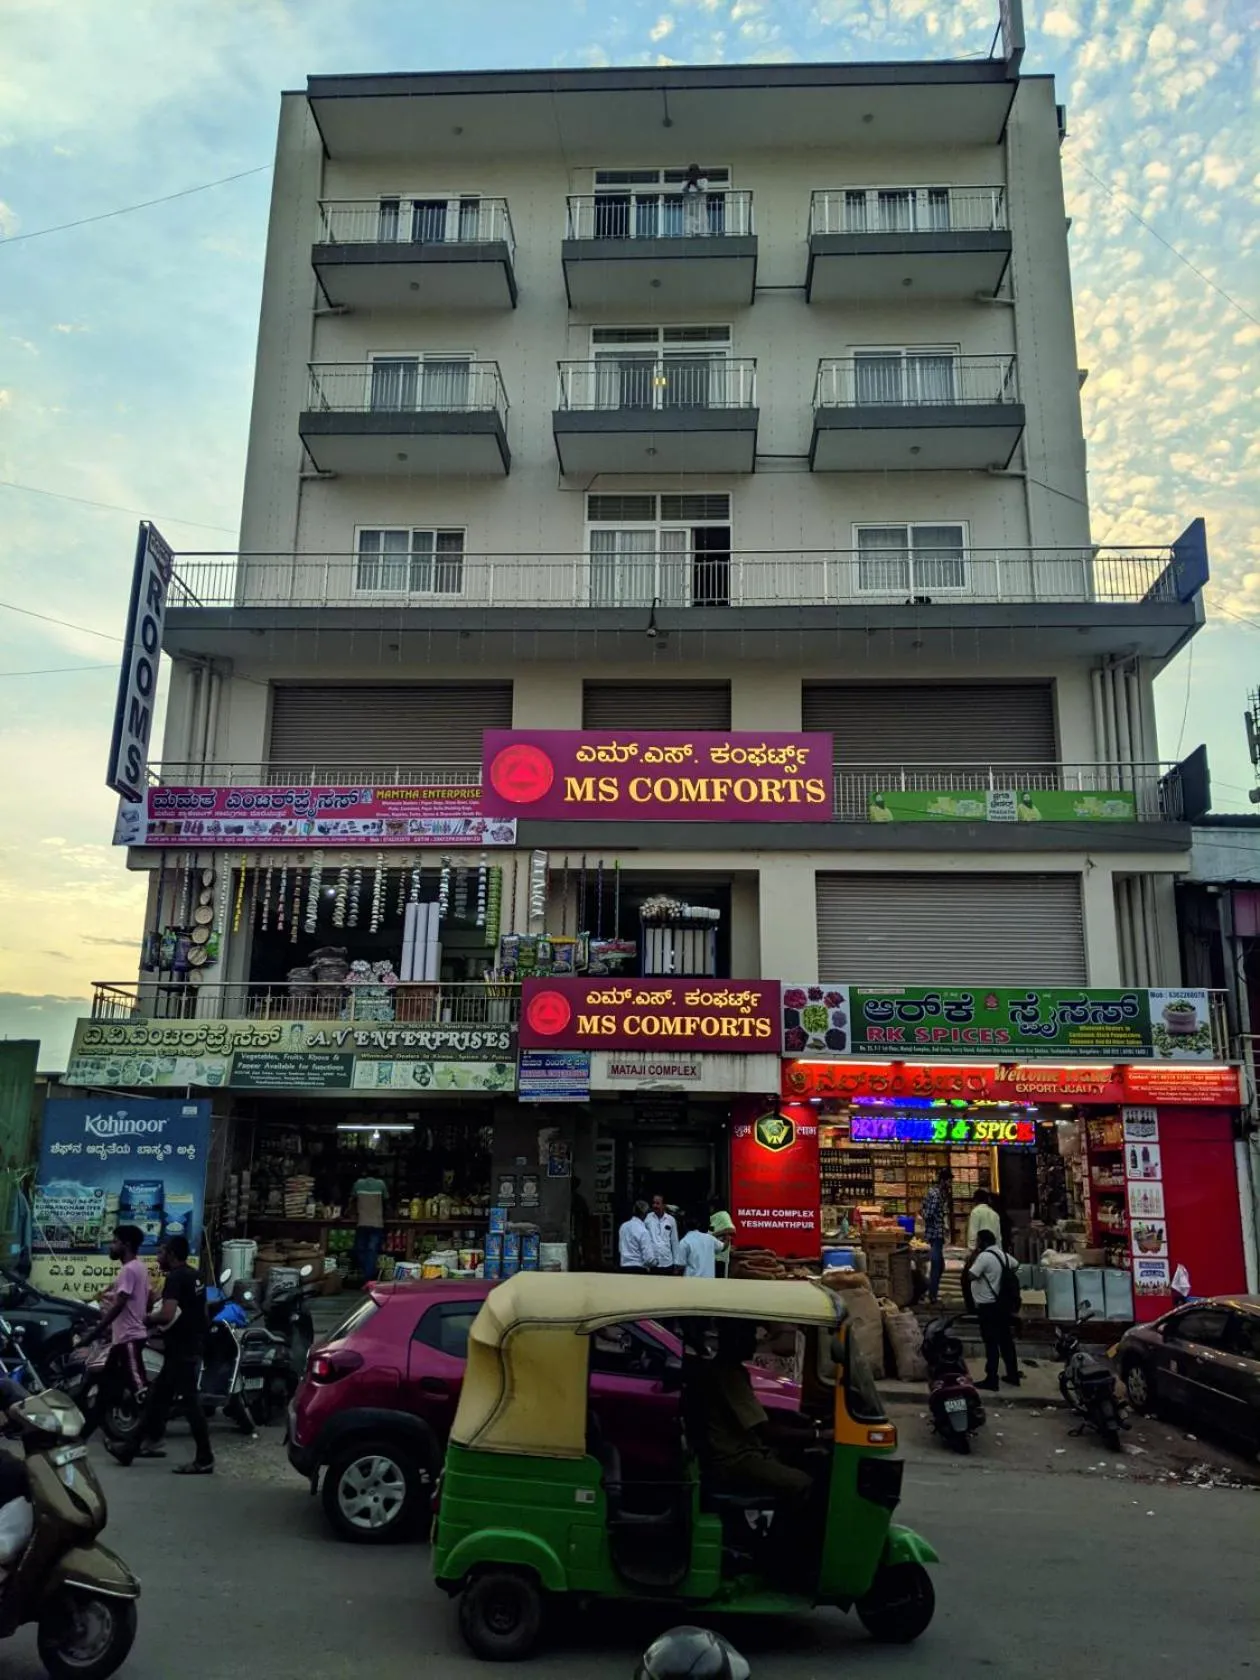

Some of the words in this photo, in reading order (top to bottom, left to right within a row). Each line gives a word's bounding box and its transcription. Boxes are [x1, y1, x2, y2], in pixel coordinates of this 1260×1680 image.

[124, 570, 162, 786] ROOMS
[564, 777, 619, 803] MS
[628, 778, 827, 803] COMFORTS
[576, 1016, 616, 1036] MS
[622, 1016, 772, 1038] COMFORTS
[866, 1026, 906, 1043] RK
[914, 1026, 1011, 1045] SPICES
[354, 1031, 511, 1051] ENTERPRISES
[610, 1064, 646, 1076] MATAJI
[648, 1065, 697, 1077] COMPLEX
[993, 1066, 1060, 1083] Welcome
[1015, 1083, 1056, 1093] EXPORT
[1058, 1084, 1105, 1094] QUALIY
[85, 1111, 168, 1137] Kohinoor
[951, 1119, 970, 1140] &
[738, 1209, 770, 1217] MATAJI
[772, 1210, 815, 1218] COMPLEX
[741, 1220, 815, 1230] YESHWANTHPUR
